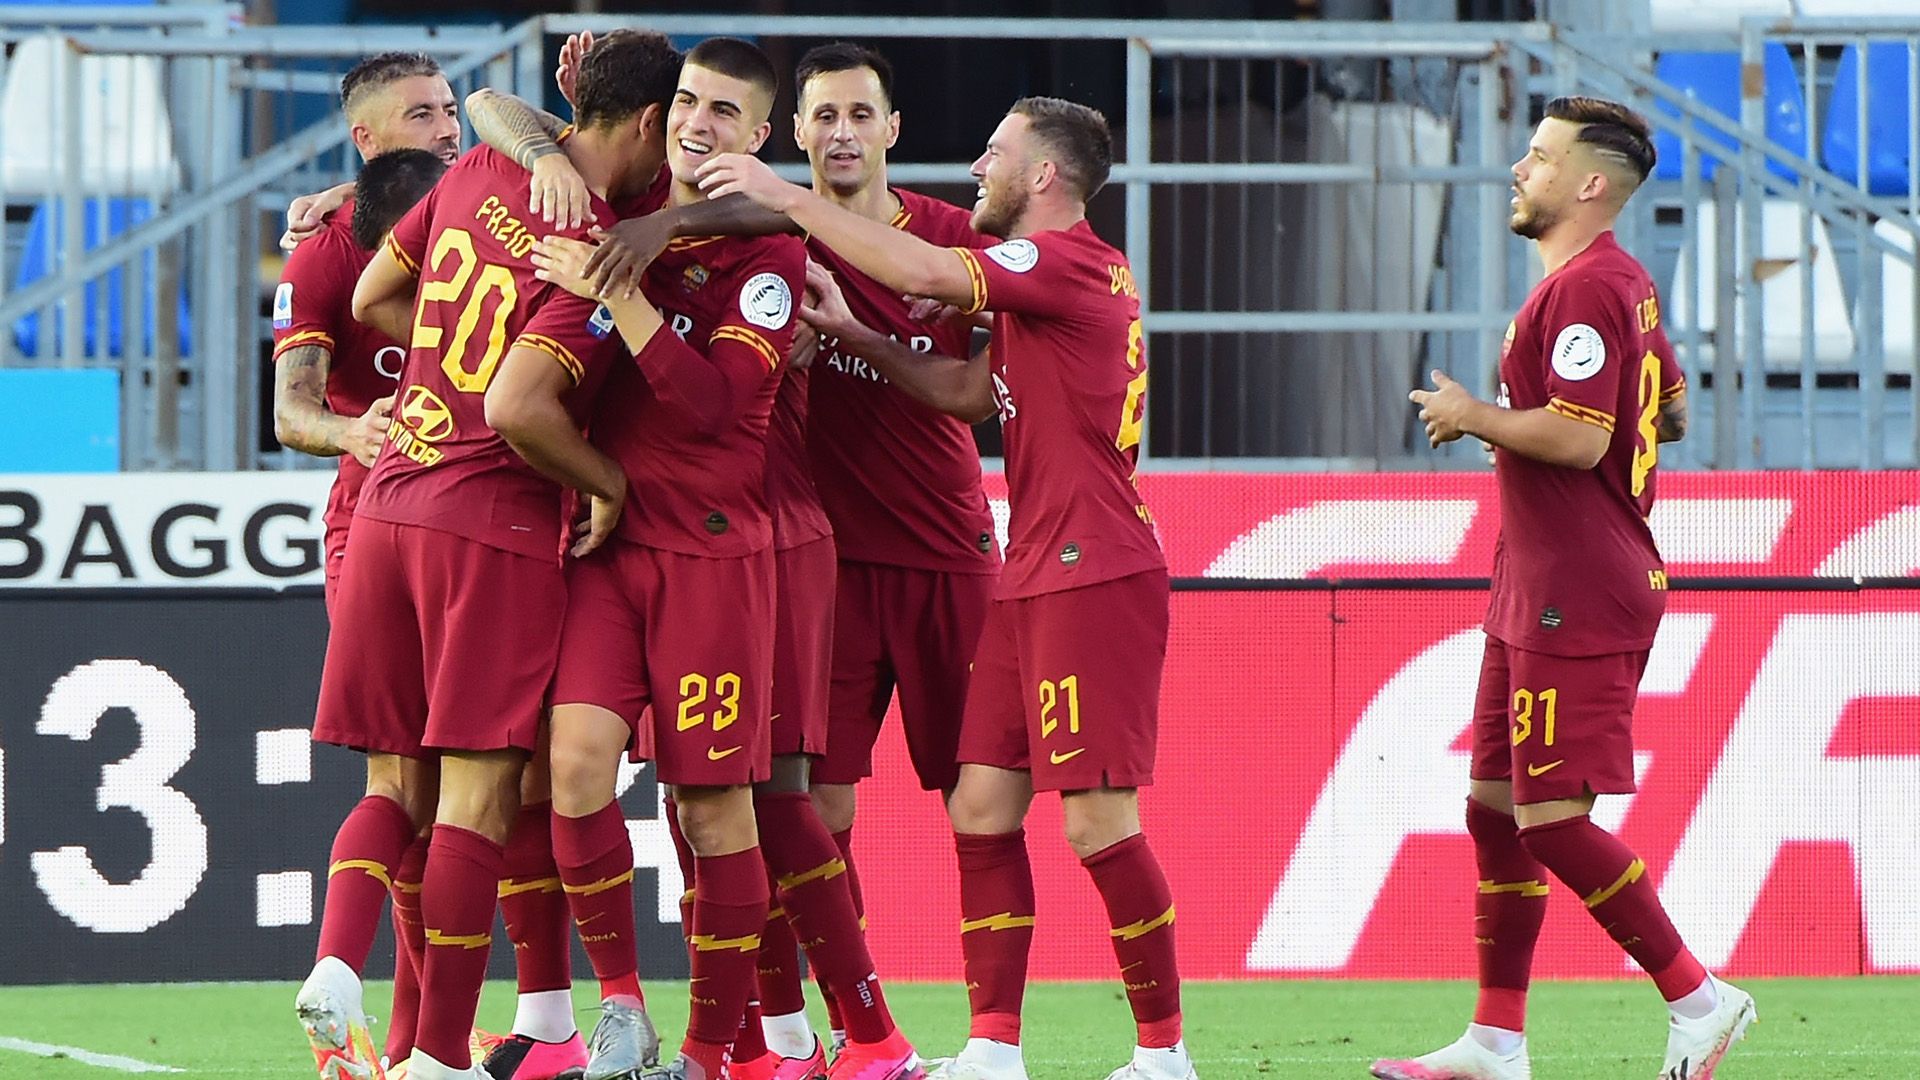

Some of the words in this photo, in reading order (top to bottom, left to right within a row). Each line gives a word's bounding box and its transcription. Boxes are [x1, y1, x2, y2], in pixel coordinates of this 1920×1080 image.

[475, 195, 536, 259] FAZIO
[410, 227, 517, 393] 20
[676, 672, 741, 732] 23
[1039, 674, 1080, 739] 21
[1512, 687, 1558, 747] 31
